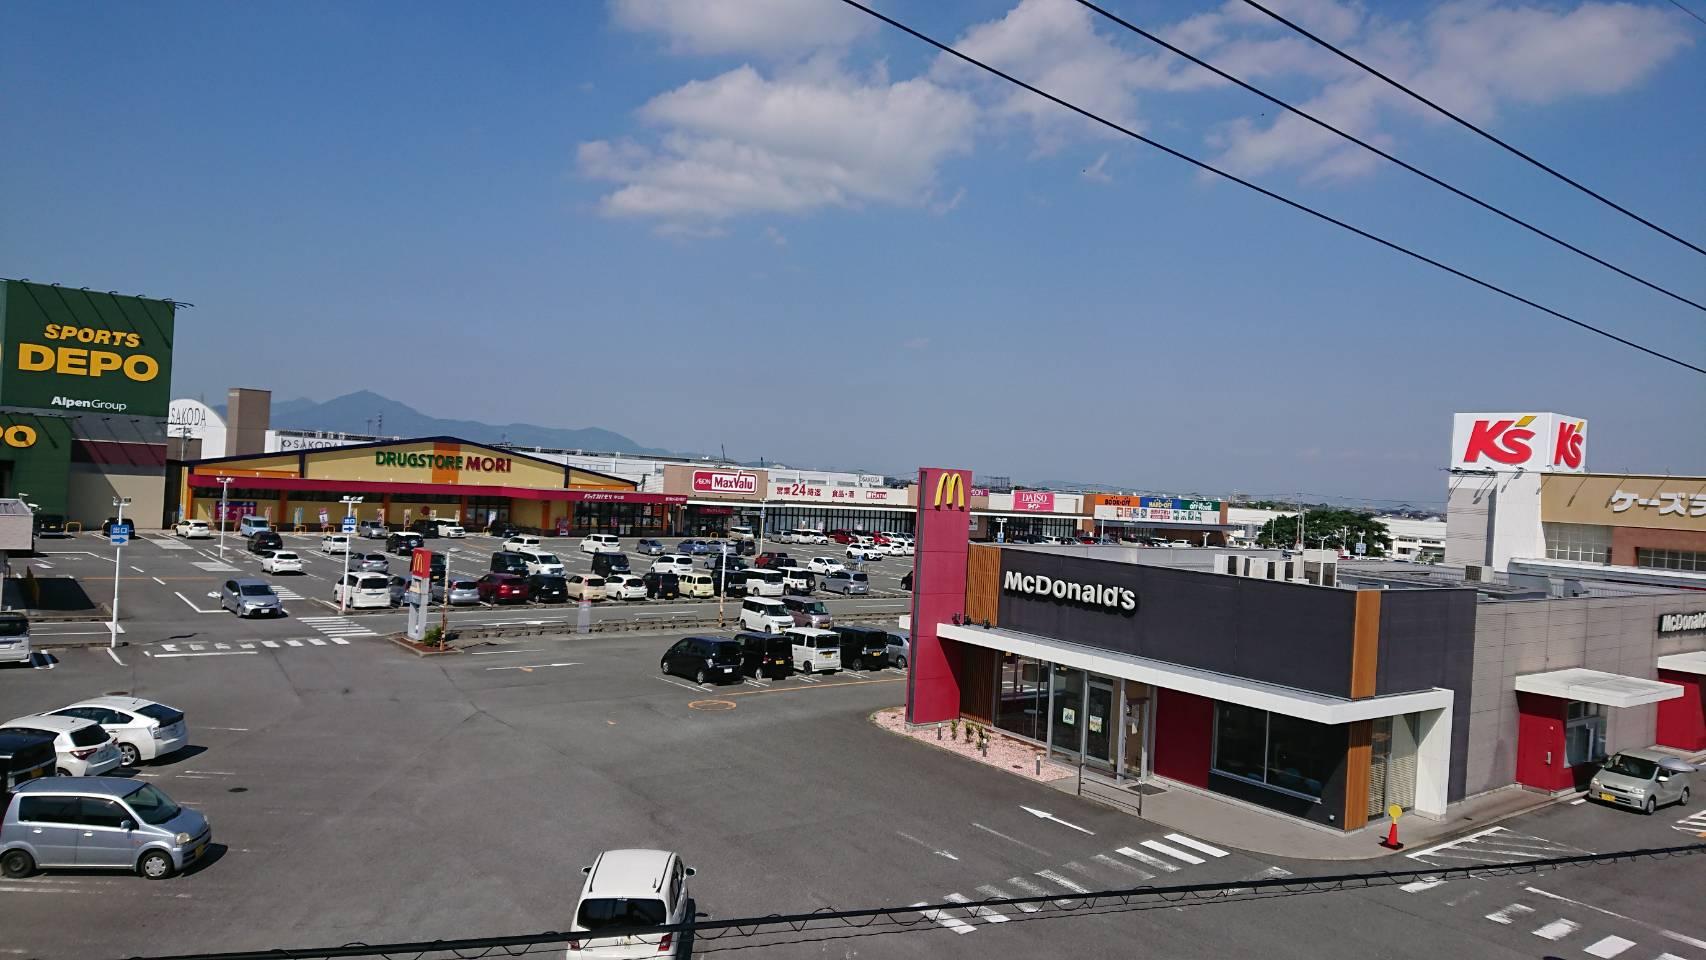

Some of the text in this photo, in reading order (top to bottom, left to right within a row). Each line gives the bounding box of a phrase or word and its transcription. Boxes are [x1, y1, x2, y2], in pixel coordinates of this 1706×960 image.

[43, 323, 141, 348] SPORTS
[18, 343, 159, 381] DEPO
[171, 407, 206, 426] SAKODA
[0, 425, 37, 448] O
[375, 451, 512, 473] DRUGSTORE MORI
[714, 473, 753, 489] MaxValu
[1022, 493, 1047, 502] DAISO
[1003, 571, 1136, 610] McDonald's
